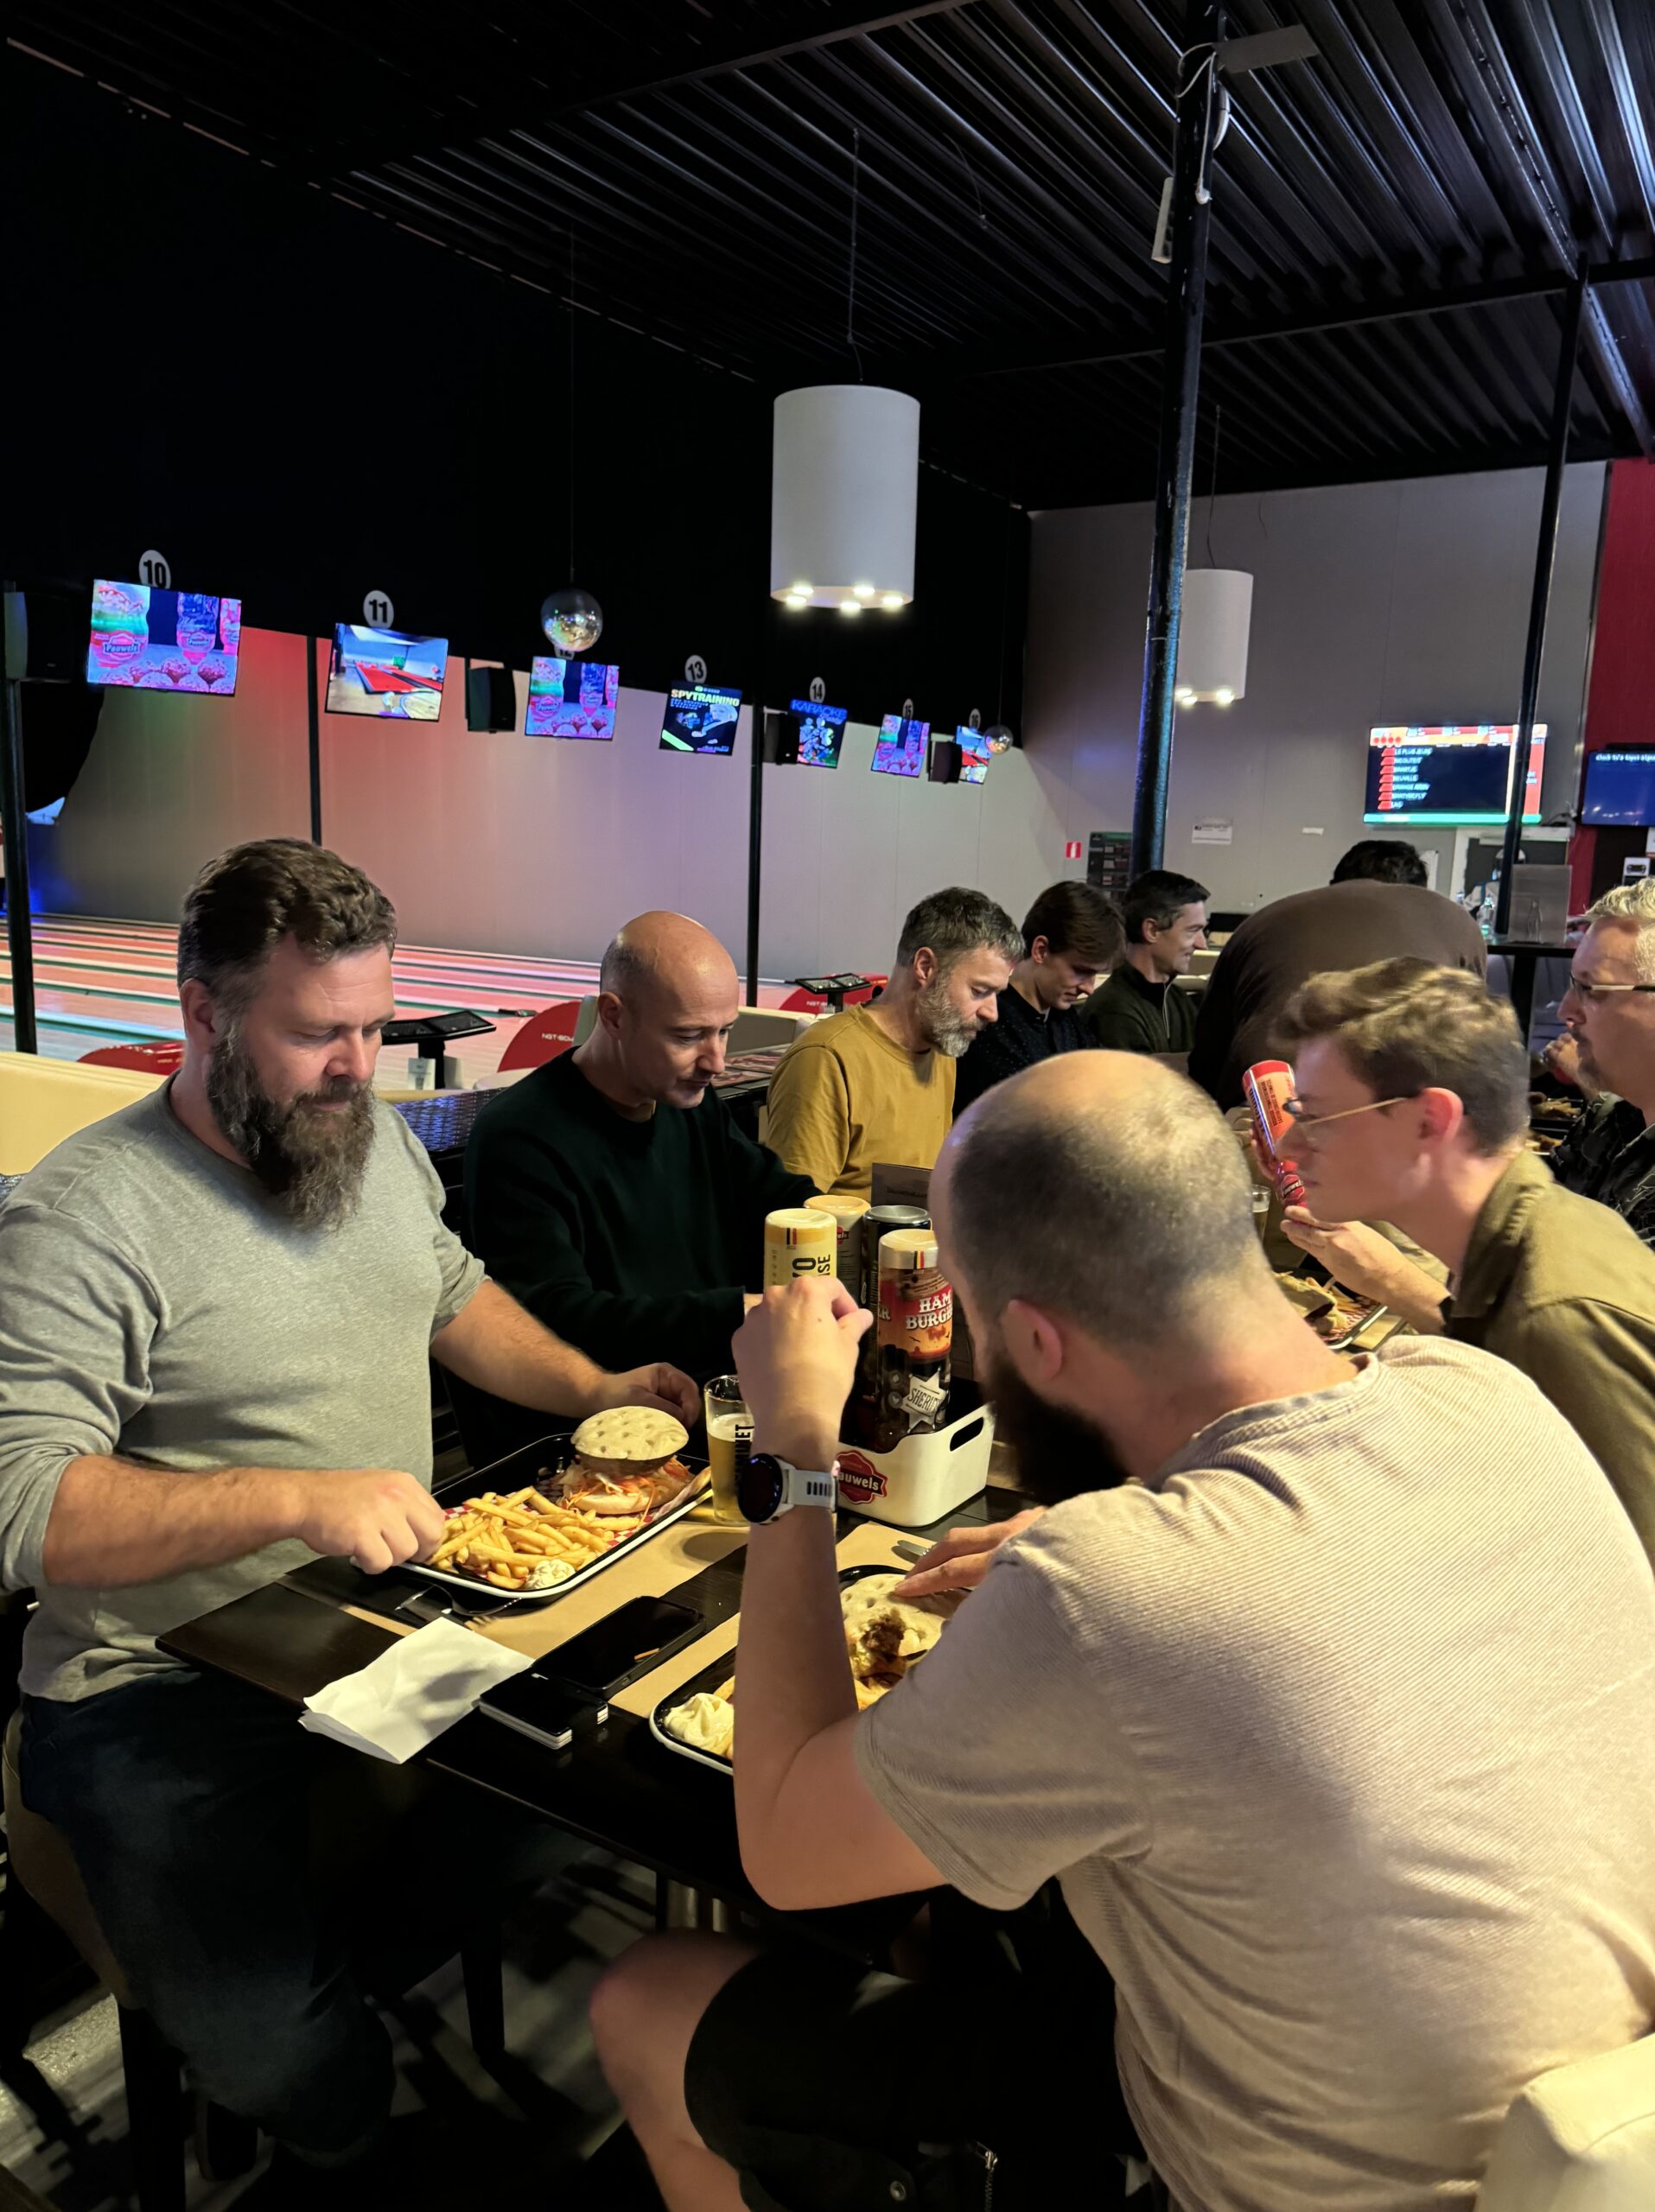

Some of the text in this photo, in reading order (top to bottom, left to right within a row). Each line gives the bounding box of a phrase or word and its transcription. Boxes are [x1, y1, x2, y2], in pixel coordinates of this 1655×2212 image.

[143, 560, 167, 588] 10
[369, 599, 388, 623] 11
[688, 661, 704, 681] 13
[812, 683, 824, 700] 14
[905, 1306, 953, 1330] BURGE
[839, 1471, 879, 1491] auwels
